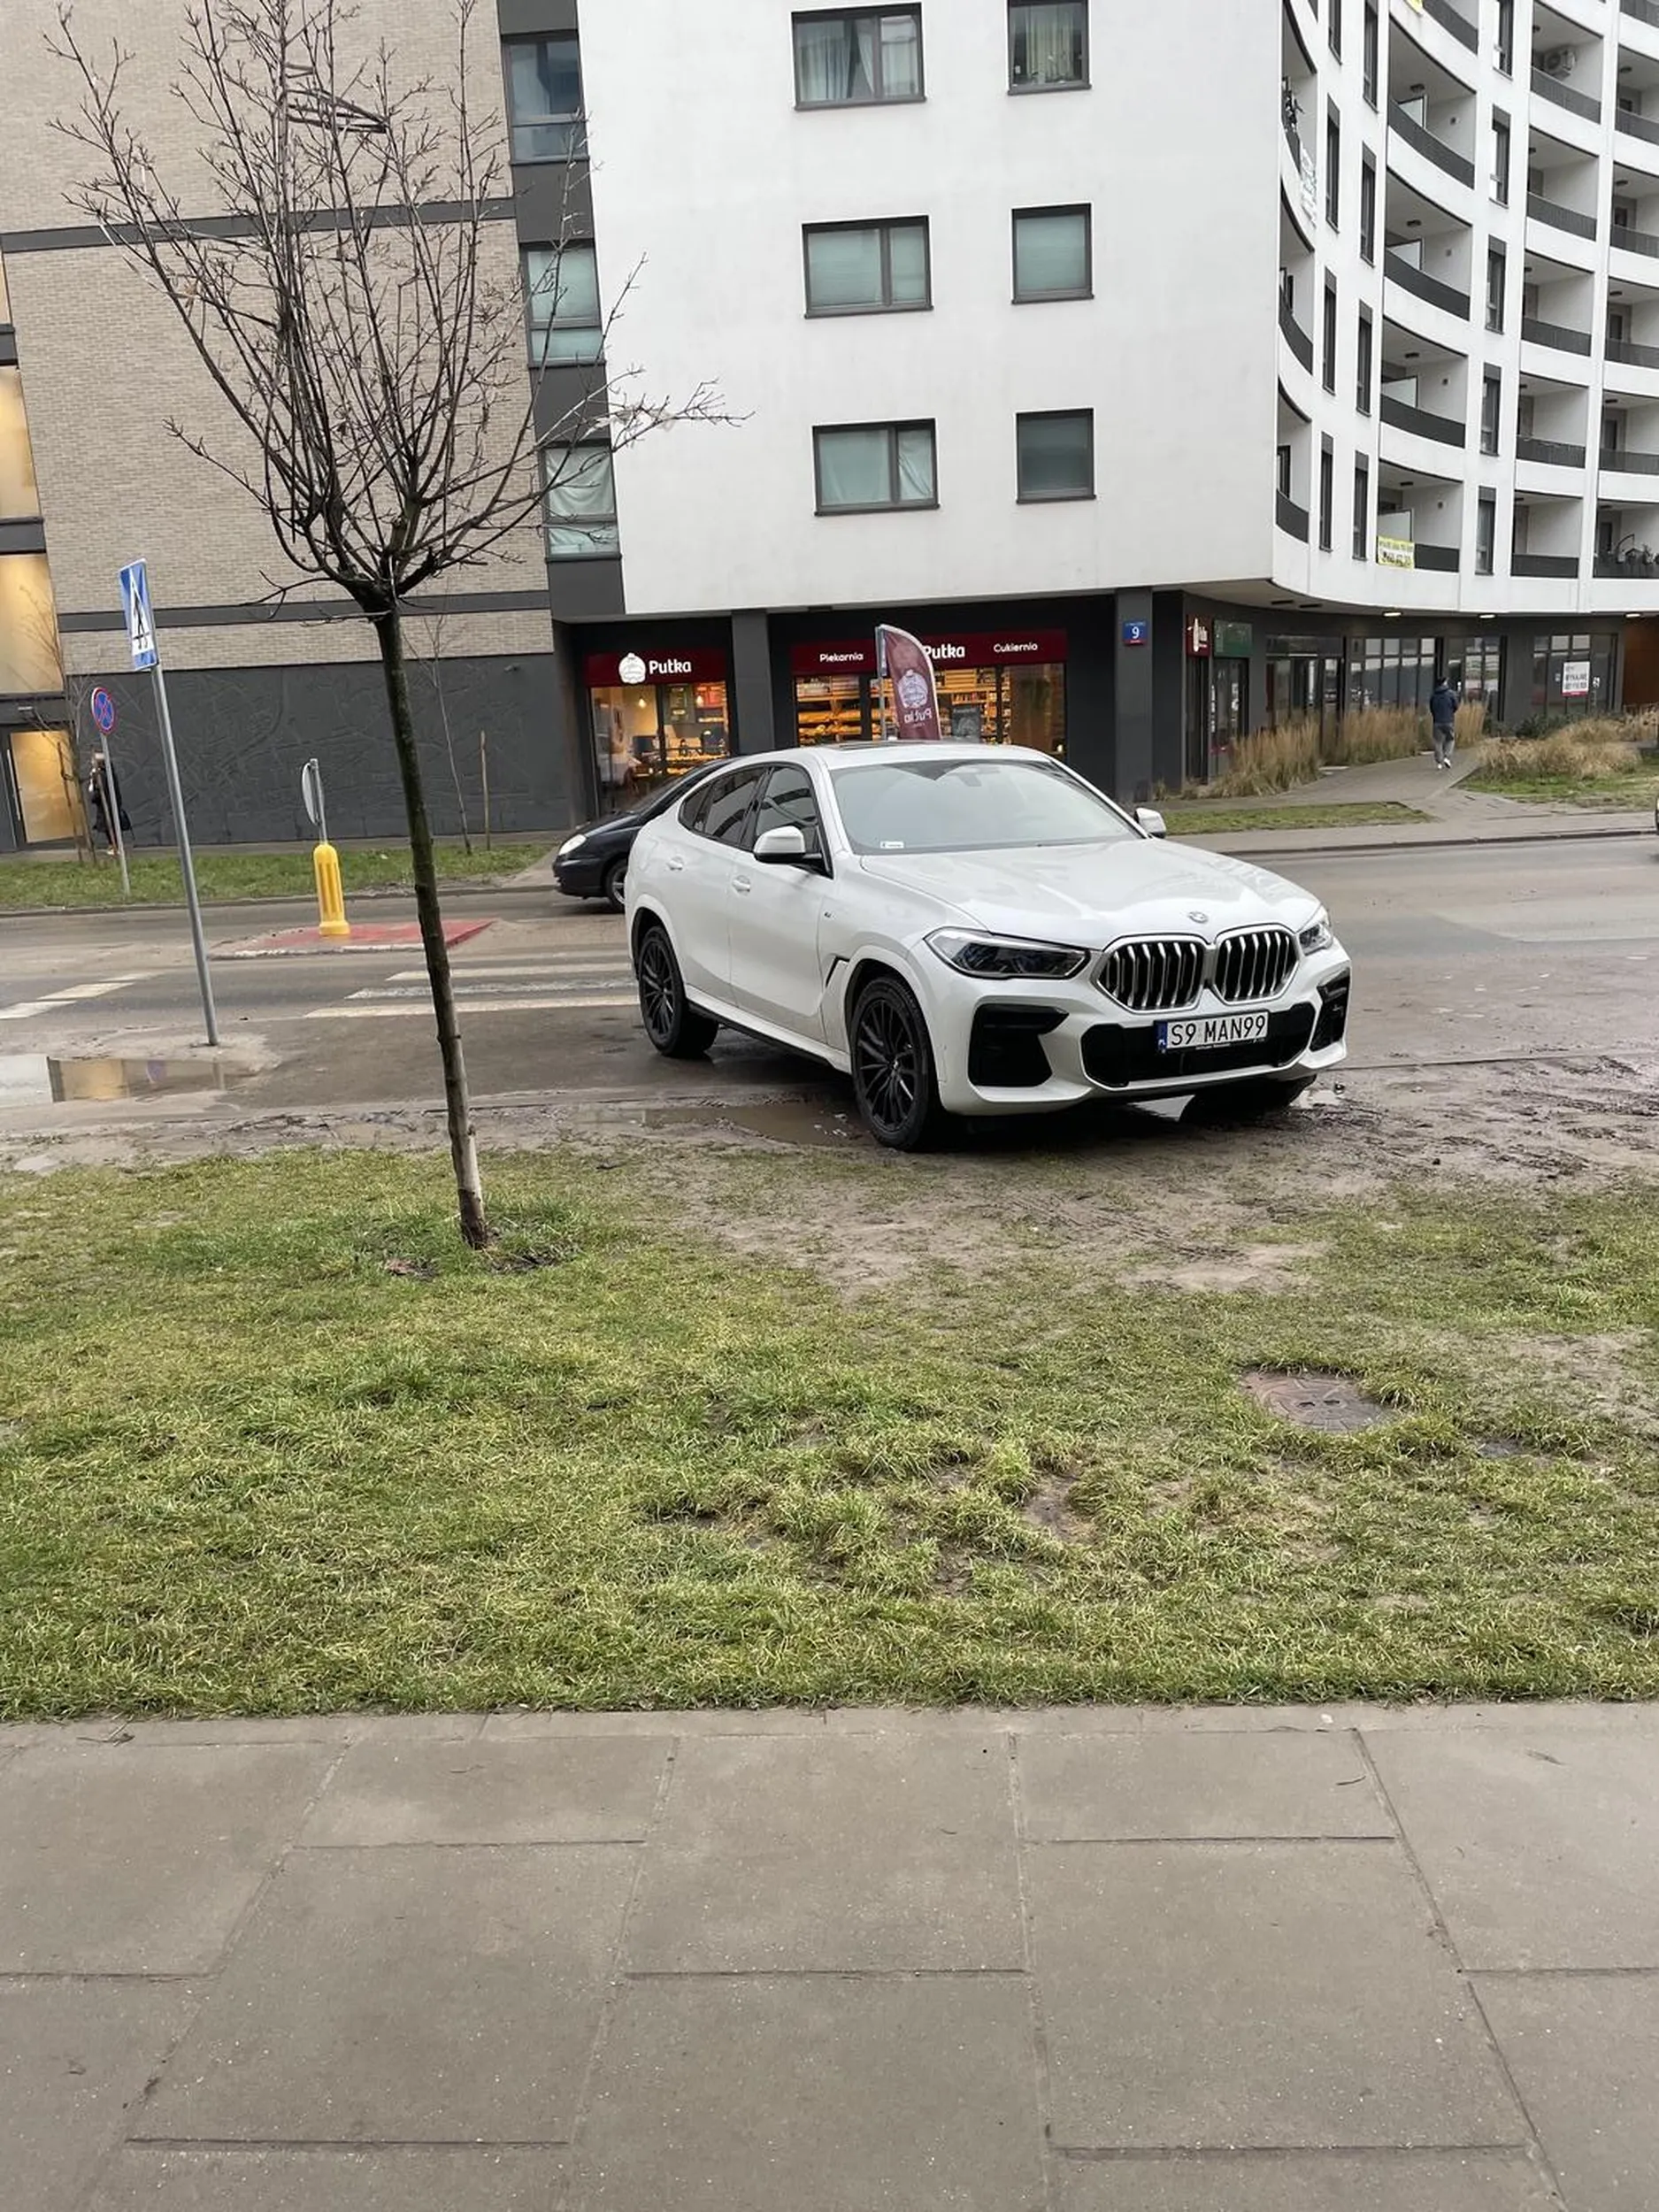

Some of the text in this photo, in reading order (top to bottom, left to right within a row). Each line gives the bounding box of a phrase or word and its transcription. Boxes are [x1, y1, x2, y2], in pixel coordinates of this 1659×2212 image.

[1132, 626, 1140, 639] 9
[819, 641, 1038, 663] Piekarnia Putka Cukiernia
[649, 658, 692, 674] Putka
[1171, 1015, 1265, 1045] S9 MAN99
